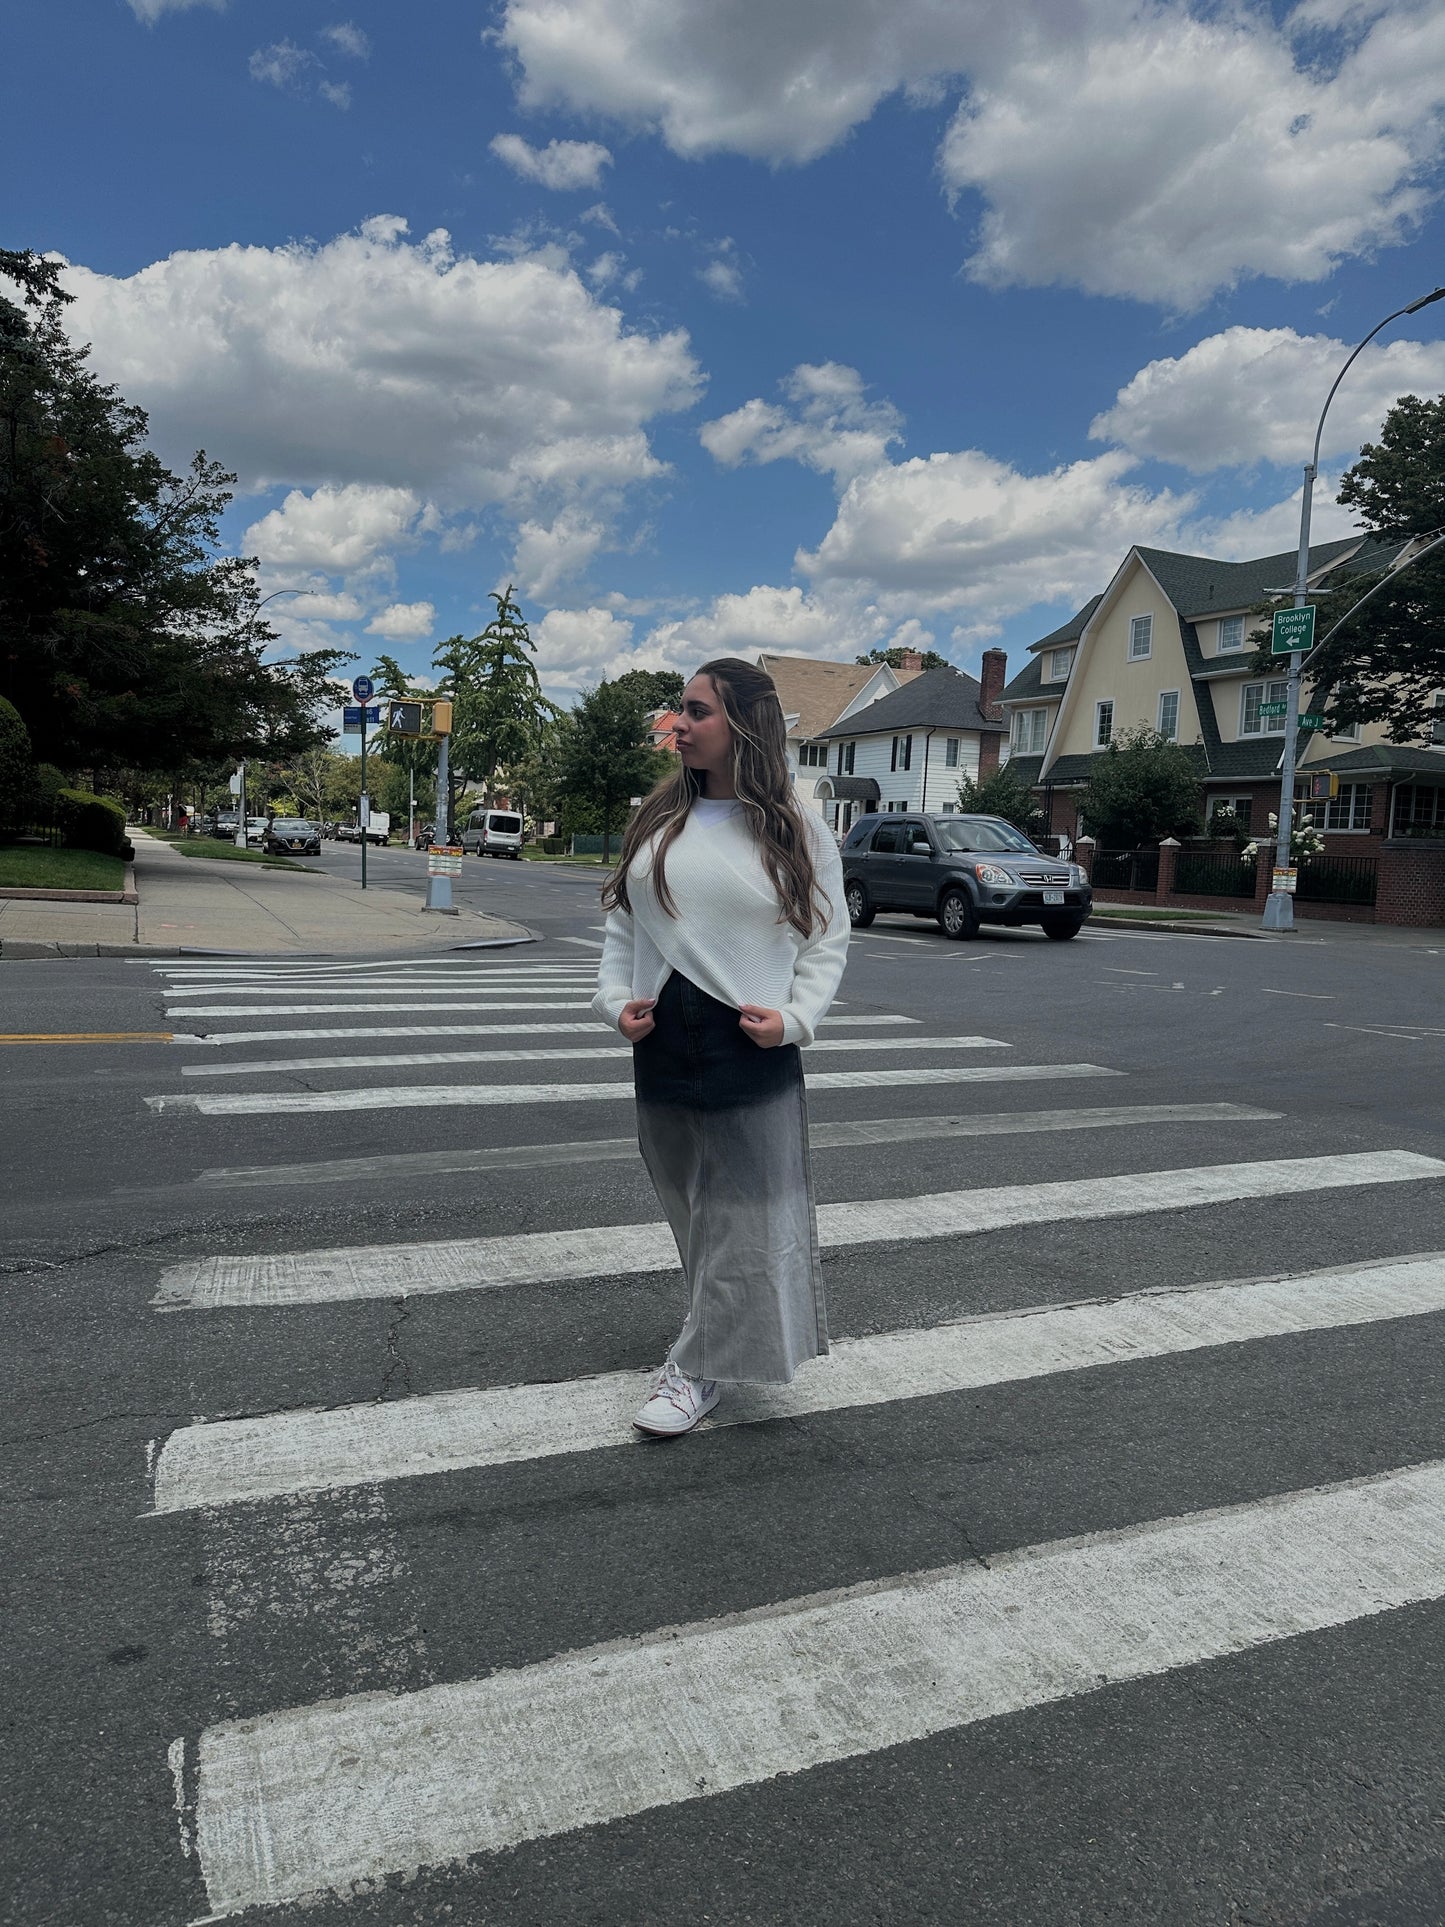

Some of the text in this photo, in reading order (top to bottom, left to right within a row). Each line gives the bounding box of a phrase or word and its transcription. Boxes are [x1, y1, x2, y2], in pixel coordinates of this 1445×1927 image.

[1277, 612, 1311, 624] Brooklyn
[1280, 624, 1307, 635] College
[1259, 704, 1280, 716] Bedford
[1301, 716, 1313, 727] Ave
